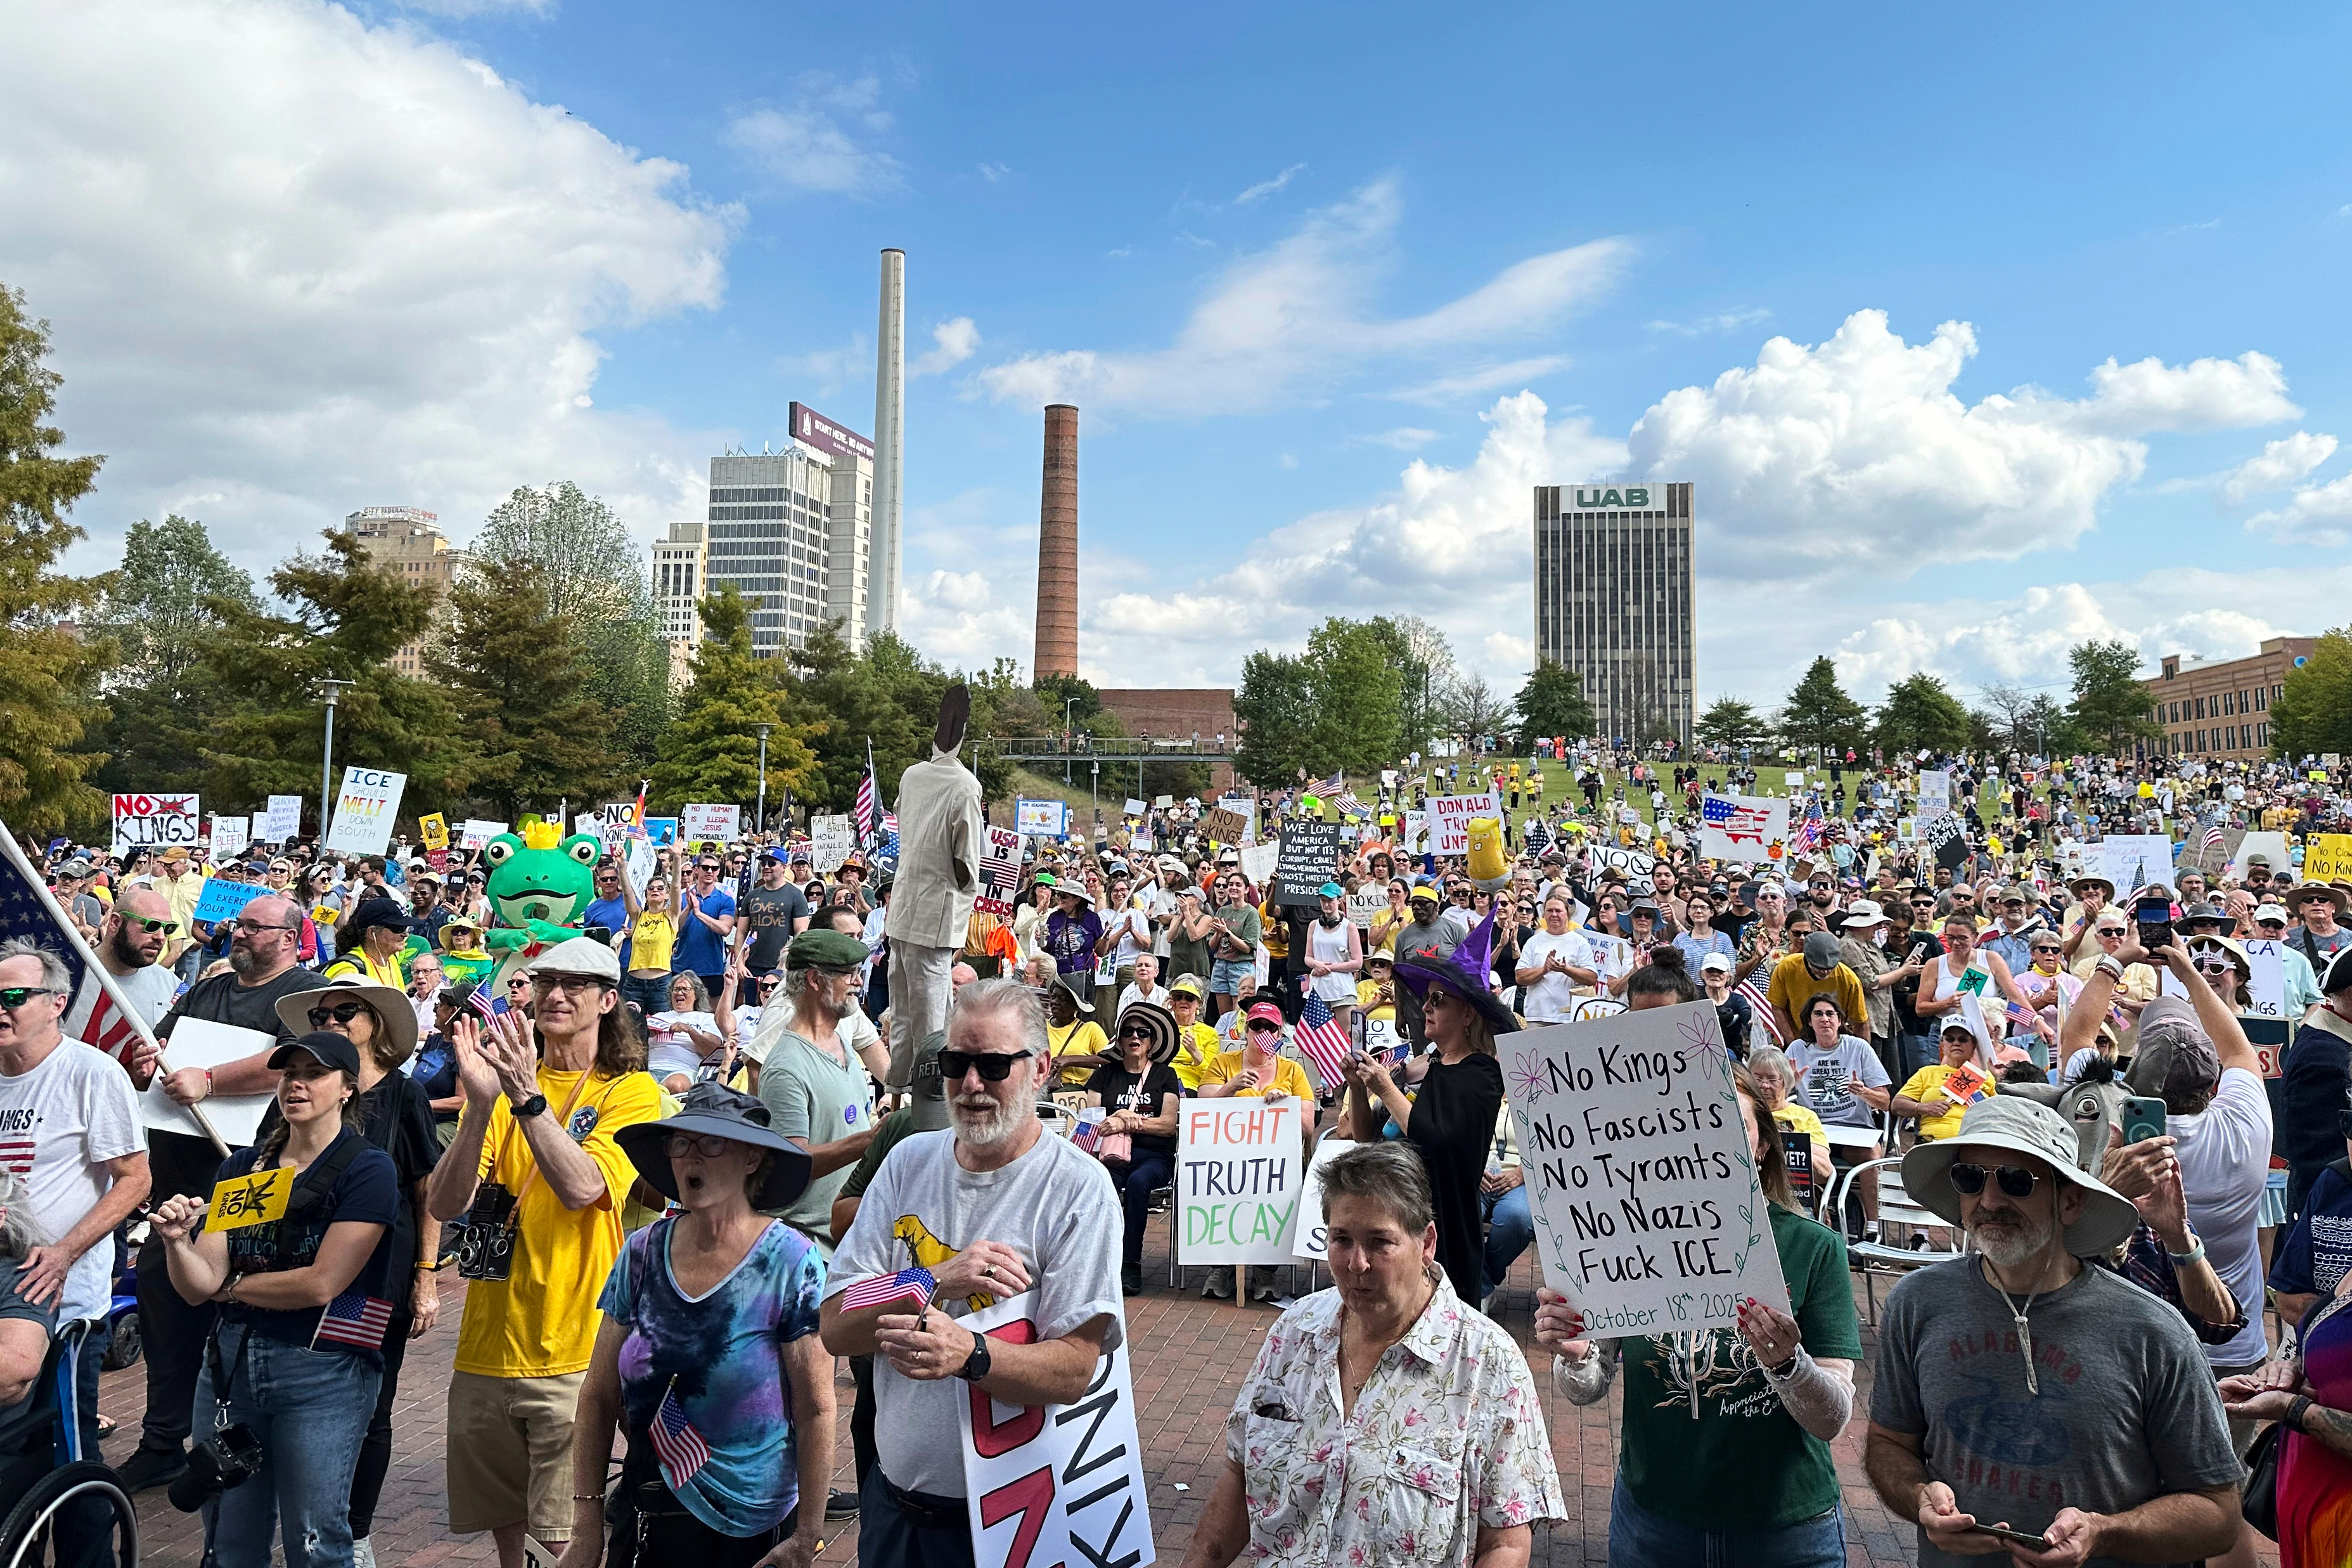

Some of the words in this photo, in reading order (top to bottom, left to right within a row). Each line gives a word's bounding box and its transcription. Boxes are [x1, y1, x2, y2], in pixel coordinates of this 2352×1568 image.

[1577, 489, 1649, 507] UAB
[350, 769, 392, 788] ICE
[352, 786, 387, 797] SHOULD
[115, 795, 153, 817] NO
[338, 795, 387, 817] MELT
[1437, 797, 1491, 815] DONALD
[349, 815, 374, 826] DOWN
[607, 805, 634, 824] NO
[813, 816, 836, 825] KATIE
[1212, 809, 1233, 825] NO
[1409, 813, 1424, 821] OUR
[115, 814, 197, 846] KINGS
[219, 824, 239, 833] ALL
[337, 825, 376, 839] SOUTH
[1284, 823, 1306, 834] WE
[1311, 825, 1335, 834] LOVE
[1924, 813, 1952, 839] POWER
[216, 834, 243, 846] BLEED
[464, 833, 493, 841] PRACTIC
[991, 829, 1019, 850] USA
[1207, 824, 1242, 846] KINGS
[1292, 835, 1329, 845] AMERICA
[1441, 834, 1468, 851] UNF
[1931, 826, 1958, 852] PEOPLE
[823, 851, 846, 860] JESUS
[994, 845, 1008, 860] IS
[1285, 844, 1303, 853] BUT
[1304, 846, 1320, 854] NOT
[2317, 845, 2329, 856] No
[1280, 854, 1311, 864] CORRUPT,
[1313, 856, 1336, 866] CRUEL,
[1593, 847, 1629, 870] NO
[2312, 859, 2330, 875] NO
[1279, 872, 1304, 882] RACIST,
[2116, 877, 2151, 887] MAA
[208, 879, 241, 892] THANK
[985, 884, 1003, 899] IN
[1284, 884, 1321, 895] PRESIDE
[215, 894, 248, 906] EXERCI
[750, 901, 774, 913] LOVE
[974, 896, 1014, 917] CRISIS
[1350, 895, 1365, 907] NO
[1366, 895, 1391, 906] KIN
[198, 902, 224, 914] YOUR
[757, 916, 786, 927] LOVE
[1587, 937, 1597, 946] YOU
[1600, 941, 1609, 949] ARE
[1546, 1051, 1593, 1094] No
[1597, 1044, 1687, 1096] Kings
[1953, 1079, 1967, 1090] NO
[1190, 1107, 1289, 1145] FIGHT
[1534, 1113, 1574, 1152] No
[1583, 1090, 1723, 1146] Fascists
[1185, 1158, 1285, 1197] TRUTH
[1543, 1157, 1588, 1190] No
[1593, 1142, 1731, 1200] Tyrants
[217, 1192, 231, 1218] KINGS
[227, 1189, 248, 1216] NO
[1186, 1200, 1294, 1247] DECAY
[1569, 1201, 1614, 1241] No
[1621, 1197, 1722, 1233] Nazis
[1578, 1247, 1663, 1284] Fuck
[1671, 1237, 1732, 1278] ICE
[1582, 1304, 1658, 1331] October
[1701, 1292, 1748, 1318] 2025
[1742, 1405, 1759, 1417] the
[1956, 1458, 2064, 1506] SHAKES
